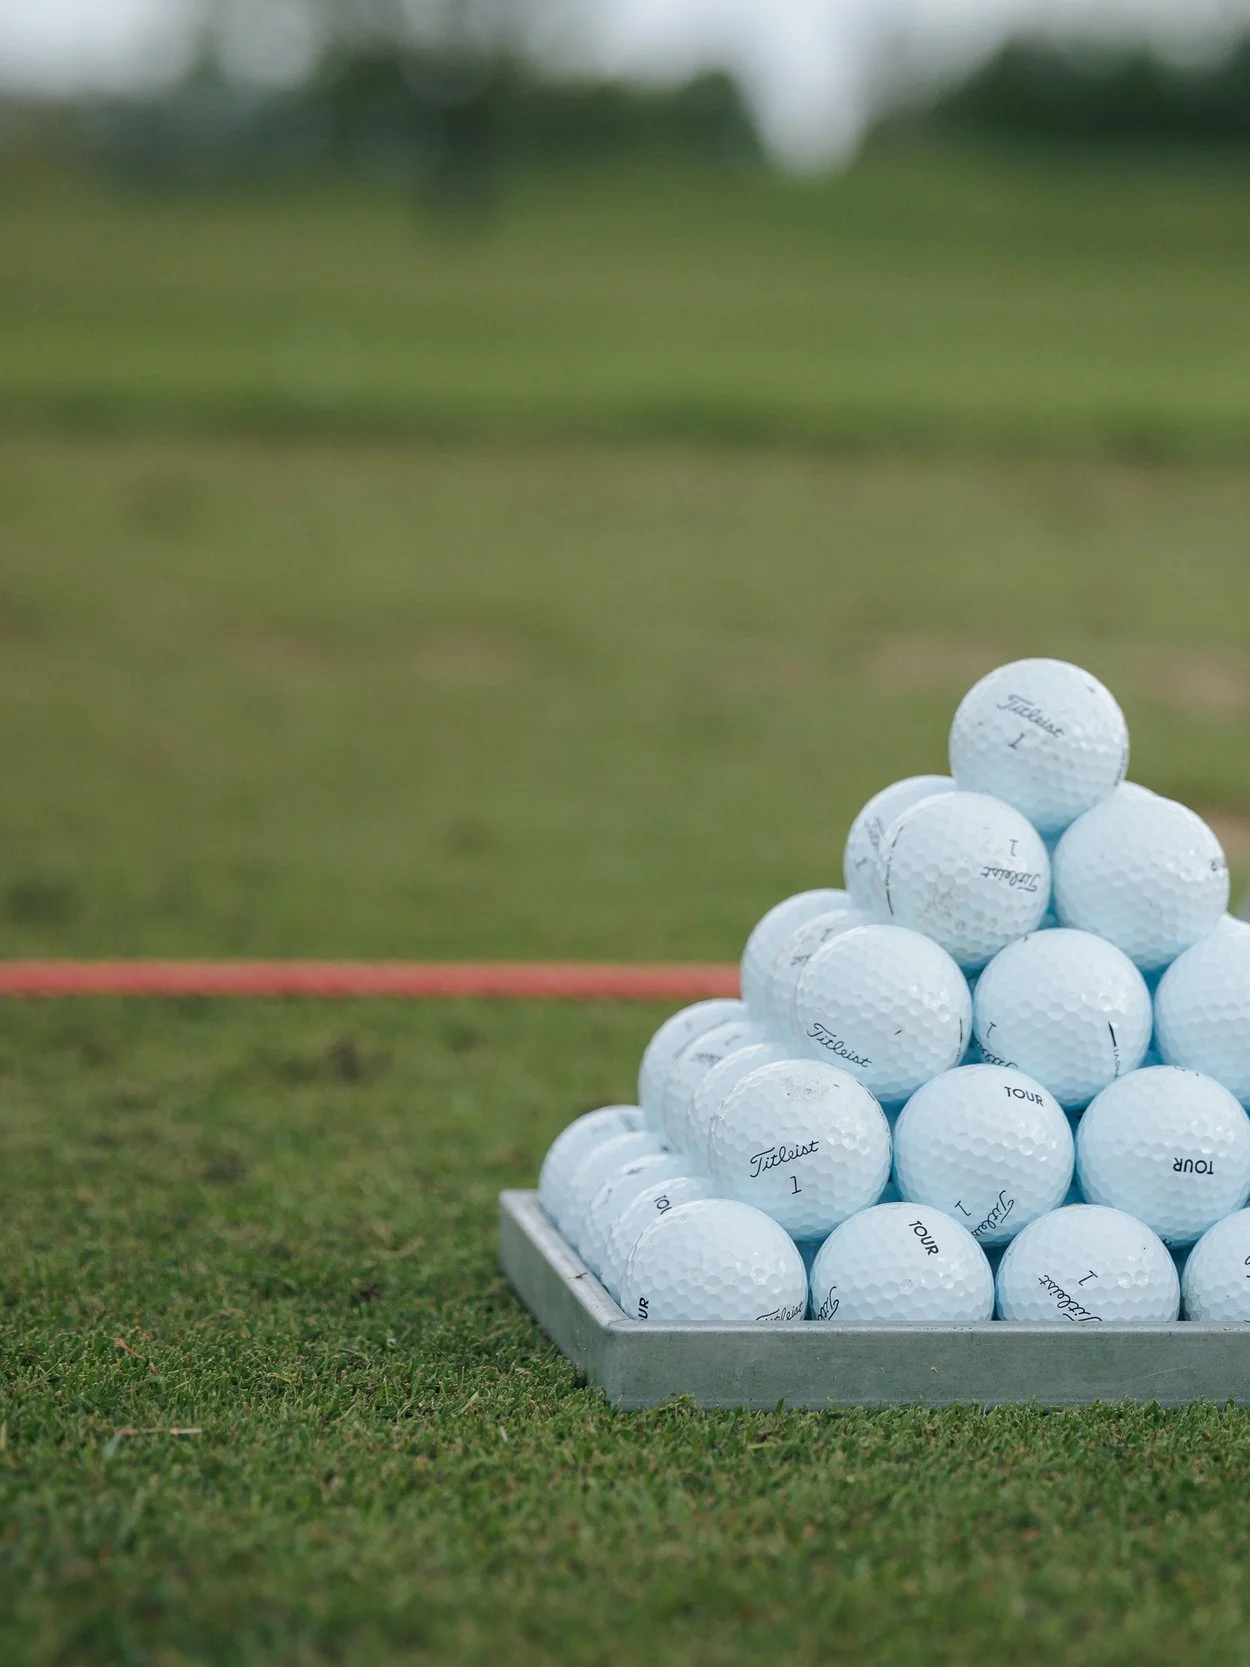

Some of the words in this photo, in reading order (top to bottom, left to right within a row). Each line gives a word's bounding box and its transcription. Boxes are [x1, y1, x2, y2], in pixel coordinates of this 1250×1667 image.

[996, 694, 1064, 739] Titleist
[1007, 733, 1025, 749] 1
[980, 866, 1041, 892] Titleist
[807, 1022, 872, 1068] Titleist
[1004, 1086, 1044, 1107] TOUR
[749, 1140, 819, 1178] Titleist
[1173, 1157, 1214, 1175] TOUR
[790, 1175, 802, 1195] 1
[908, 1220, 939, 1256] TOUR
[1078, 1270, 1099, 1286] 1
